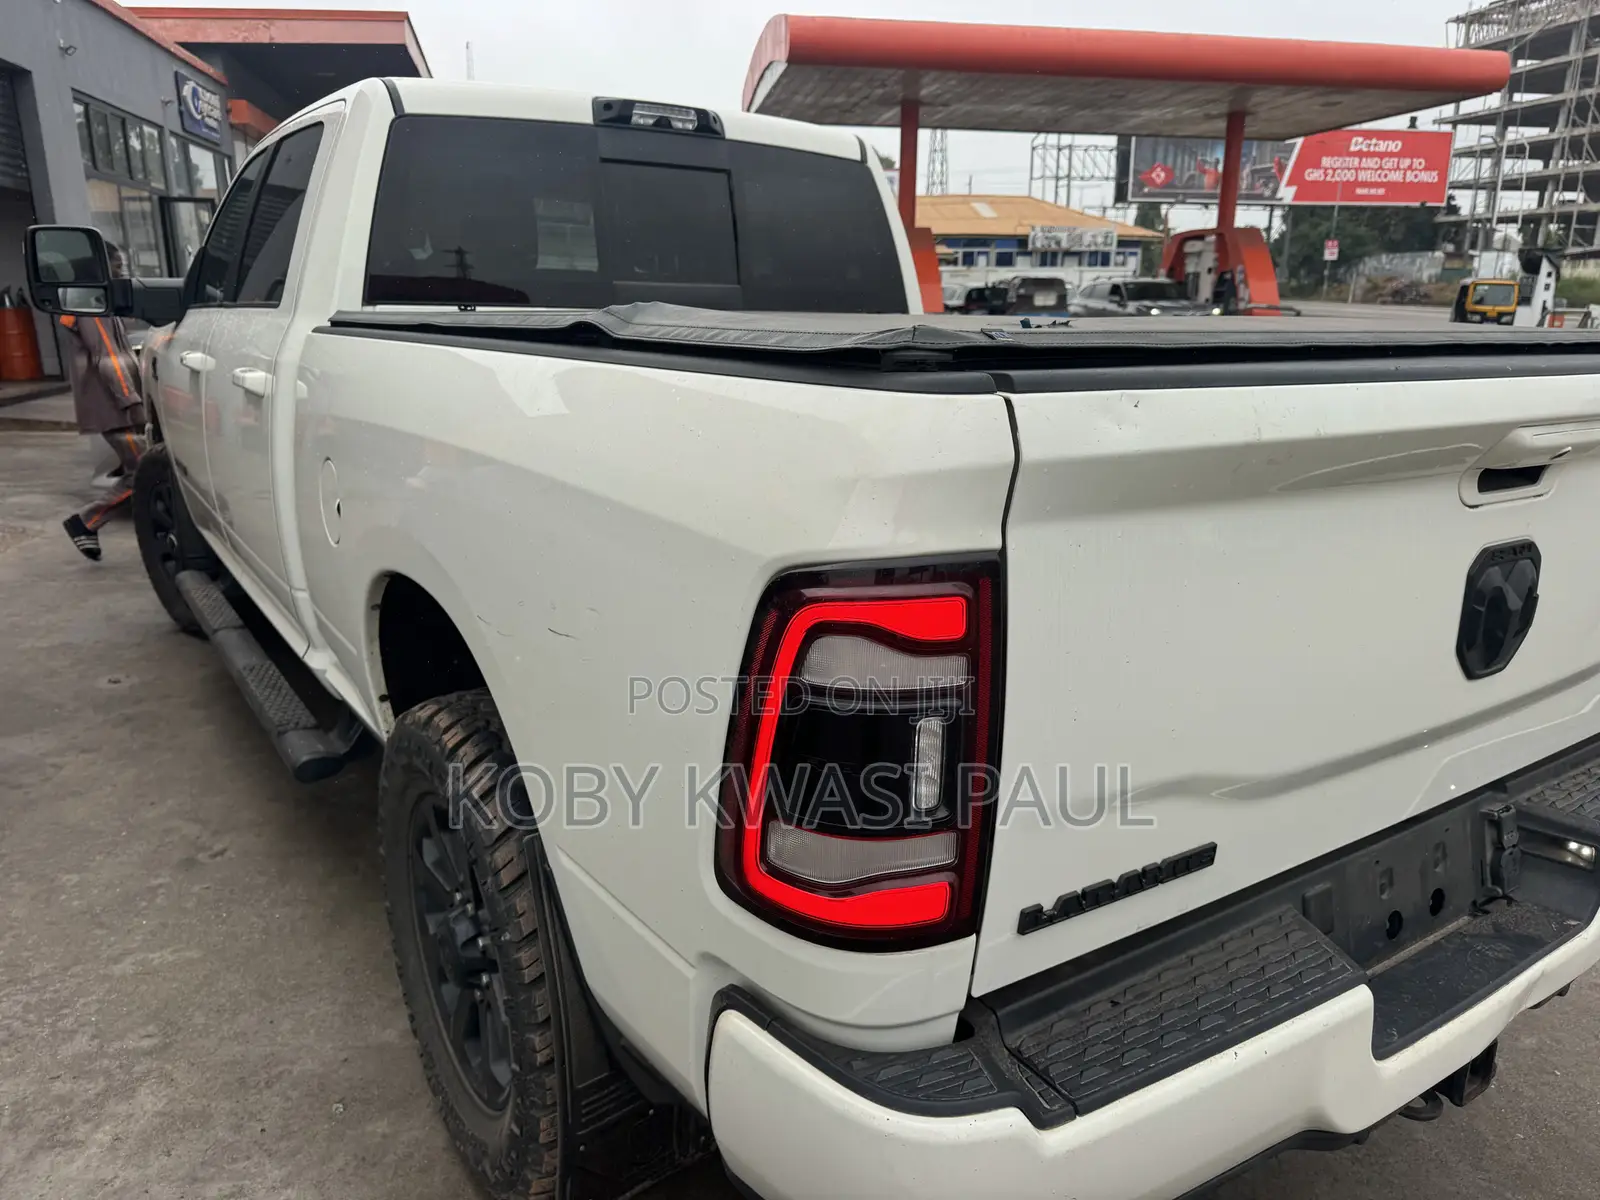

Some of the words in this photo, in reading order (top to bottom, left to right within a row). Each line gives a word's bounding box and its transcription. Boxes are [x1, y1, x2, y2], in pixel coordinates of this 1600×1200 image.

[1349, 136, 1403, 153] Betano
[1321, 156, 1360, 169] REGISTER
[1360, 157, 1380, 169] AND
[1381, 158, 1399, 169] GET
[1399, 158, 1412, 170] UP
[1412, 158, 1426, 170] TO
[1326, 169, 1357, 183] 2,000
[1357, 170, 1404, 182] WELCOME
[1405, 170, 1439, 183] BONUS
